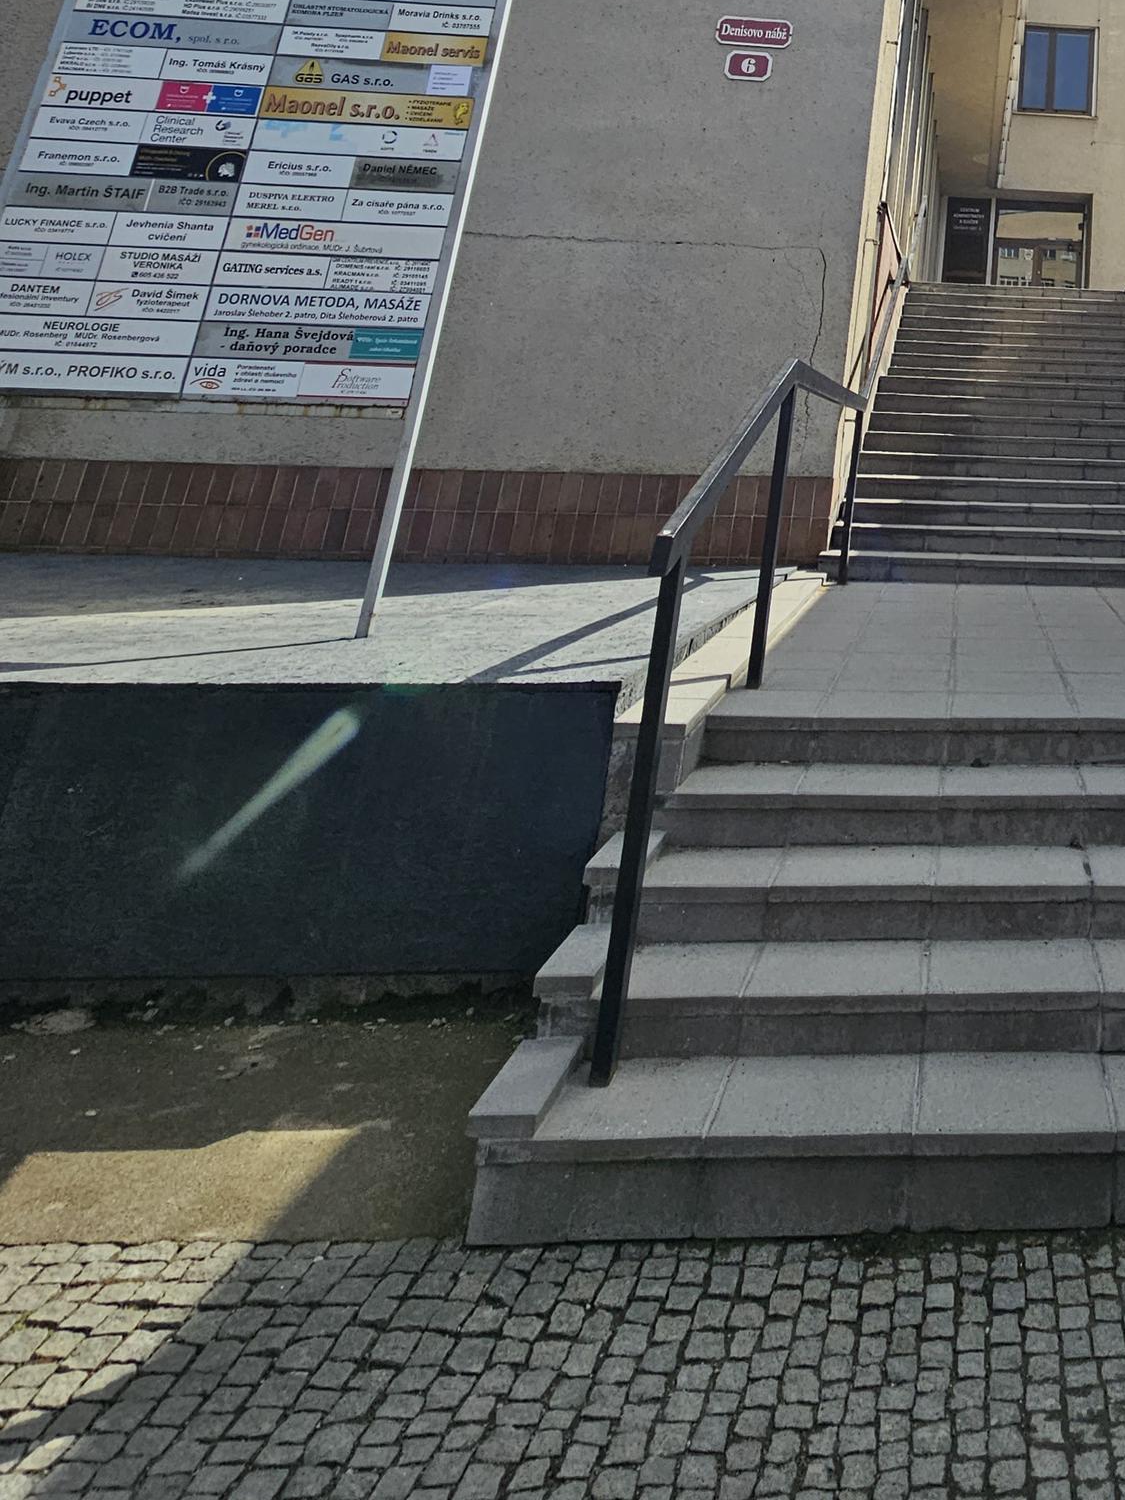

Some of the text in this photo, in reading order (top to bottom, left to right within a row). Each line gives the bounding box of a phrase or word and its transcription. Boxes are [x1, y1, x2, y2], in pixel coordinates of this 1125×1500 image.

[397, 8, 431, 18] Moravia
[432, 11, 460, 20] Drinks
[88, 18, 182, 43] ECOM,
[187, 34, 211, 45] spol.
[721, 23, 763, 38] Denisovo
[385, 40, 481, 59] Maonel servis
[168, 58, 189, 69] Ing.
[192, 57, 226, 69] Tomáš
[229, 60, 265, 73] Krásný
[741, 58, 756, 74] 6
[331, 73, 394, 87] GAS s.r.o.
[65, 88, 132, 106] puppet
[264, 93, 347, 116] Maonel
[349, 102, 400, 120] s.r.o.
[49, 116, 131, 128] Evava Czech s.r.o.
[156, 115, 196, 126] Clinical
[153, 125, 204, 136] Research
[150, 133, 187, 143] Center
[38, 150, 120, 163] Franemon s.r.o.
[267, 161, 332, 173] Ericius s.r.o.
[363, 163, 438, 175] Daniel NĚMEC
[25, 182, 147, 200] Ing. Martin ŠTAIF
[158, 185, 229, 198] B2B Trade s.r.o.
[248, 191, 335, 202] DUSPIVA ELEKTRO
[246, 202, 279, 211] MEREL
[351, 198, 364, 207] Za
[396, 202, 420, 211] pána
[422, 203, 445, 211] s.r.o.
[4, 218, 108, 229] LUCKY FINANCE s.r.o.
[126, 219, 214, 232] Jevhenia Shanta
[148, 231, 187, 242] cvičení
[260, 223, 335, 242] MedGen
[55, 252, 92, 261] HOLEX
[119, 251, 202, 263] STUDIO MASÁŽÍ
[133, 261, 183, 270] VERONIKA
[222, 263, 323, 276] GATING services a.s.
[10, 283, 61, 294] DANTEM
[131, 288, 200, 301] David Šimek
[41, 294, 80, 304] inventury
[135, 299, 191, 308] fyzioterapeut
[217, 292, 423, 312] DORNOVA METODA, MASÁŽE
[213, 308, 247, 318] Jaroslav
[247, 308, 283, 319] Šlehober
[284, 311, 293, 319] 2.
[294, 311, 319, 321] patro,
[320, 312, 337, 321] Dita
[337, 311, 388, 322] Šlehoberová
[397, 316, 419, 324] patro
[42, 321, 120, 332] NEUROLOGIE
[23, 330, 68, 340] Rosenberg
[101, 332, 160, 343] Rosenbergová
[223, 326, 354, 343] Ing. Hana Švejdová
[229, 341, 280, 355] daňový
[282, 342, 337, 356] poradce
[22, 364, 176, 380] s.r.o., PROFIKO s.r.o.
[194, 363, 227, 378] vida
[339, 368, 382, 384] Software
